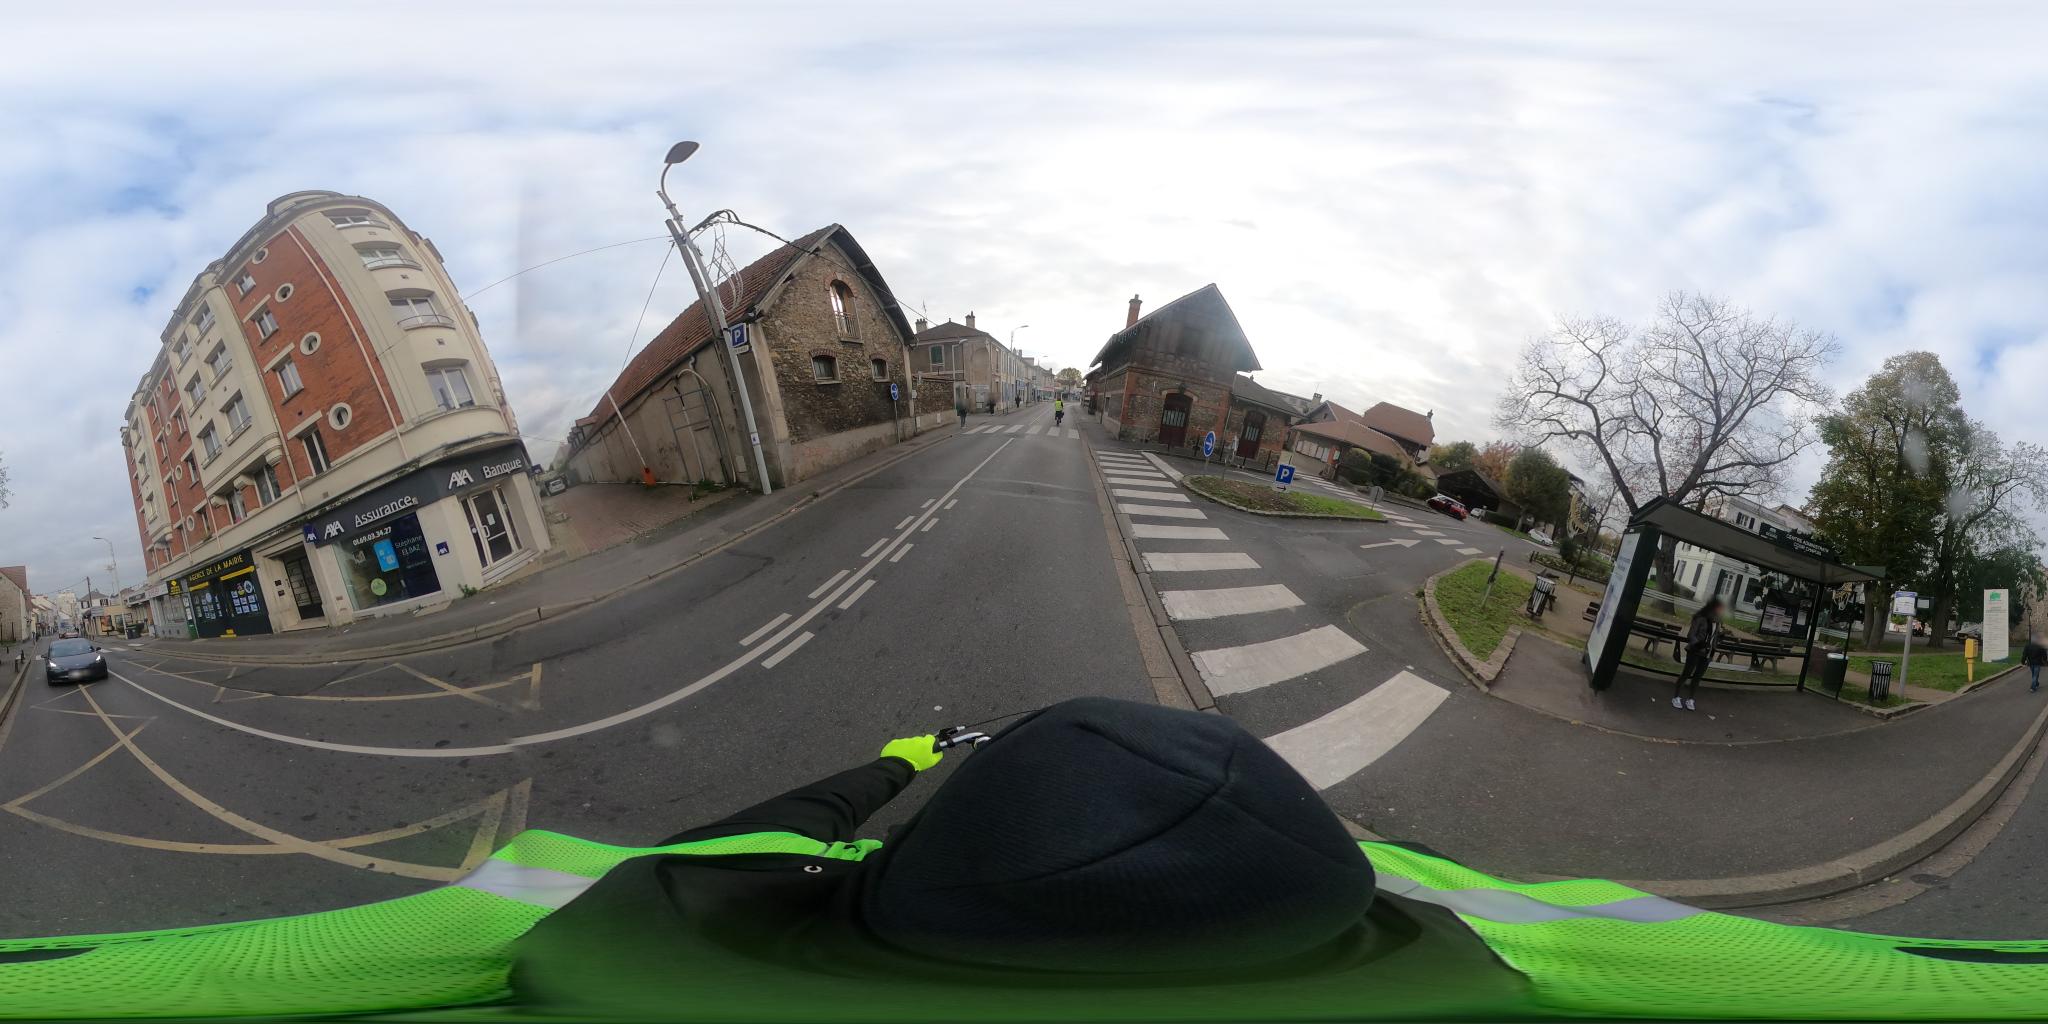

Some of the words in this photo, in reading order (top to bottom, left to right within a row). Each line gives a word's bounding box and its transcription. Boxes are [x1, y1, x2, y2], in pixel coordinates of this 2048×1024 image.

[734, 330, 741, 343] P
[448, 468, 475, 490] AXA
[482, 457, 523, 479] Banque
[1281, 469, 1289, 479] P
[324, 520, 345, 540] AXA
[206, 567, 213, 576] DE
[214, 563, 222, 574] LA
[223, 554, 243, 569] MAIRIE
